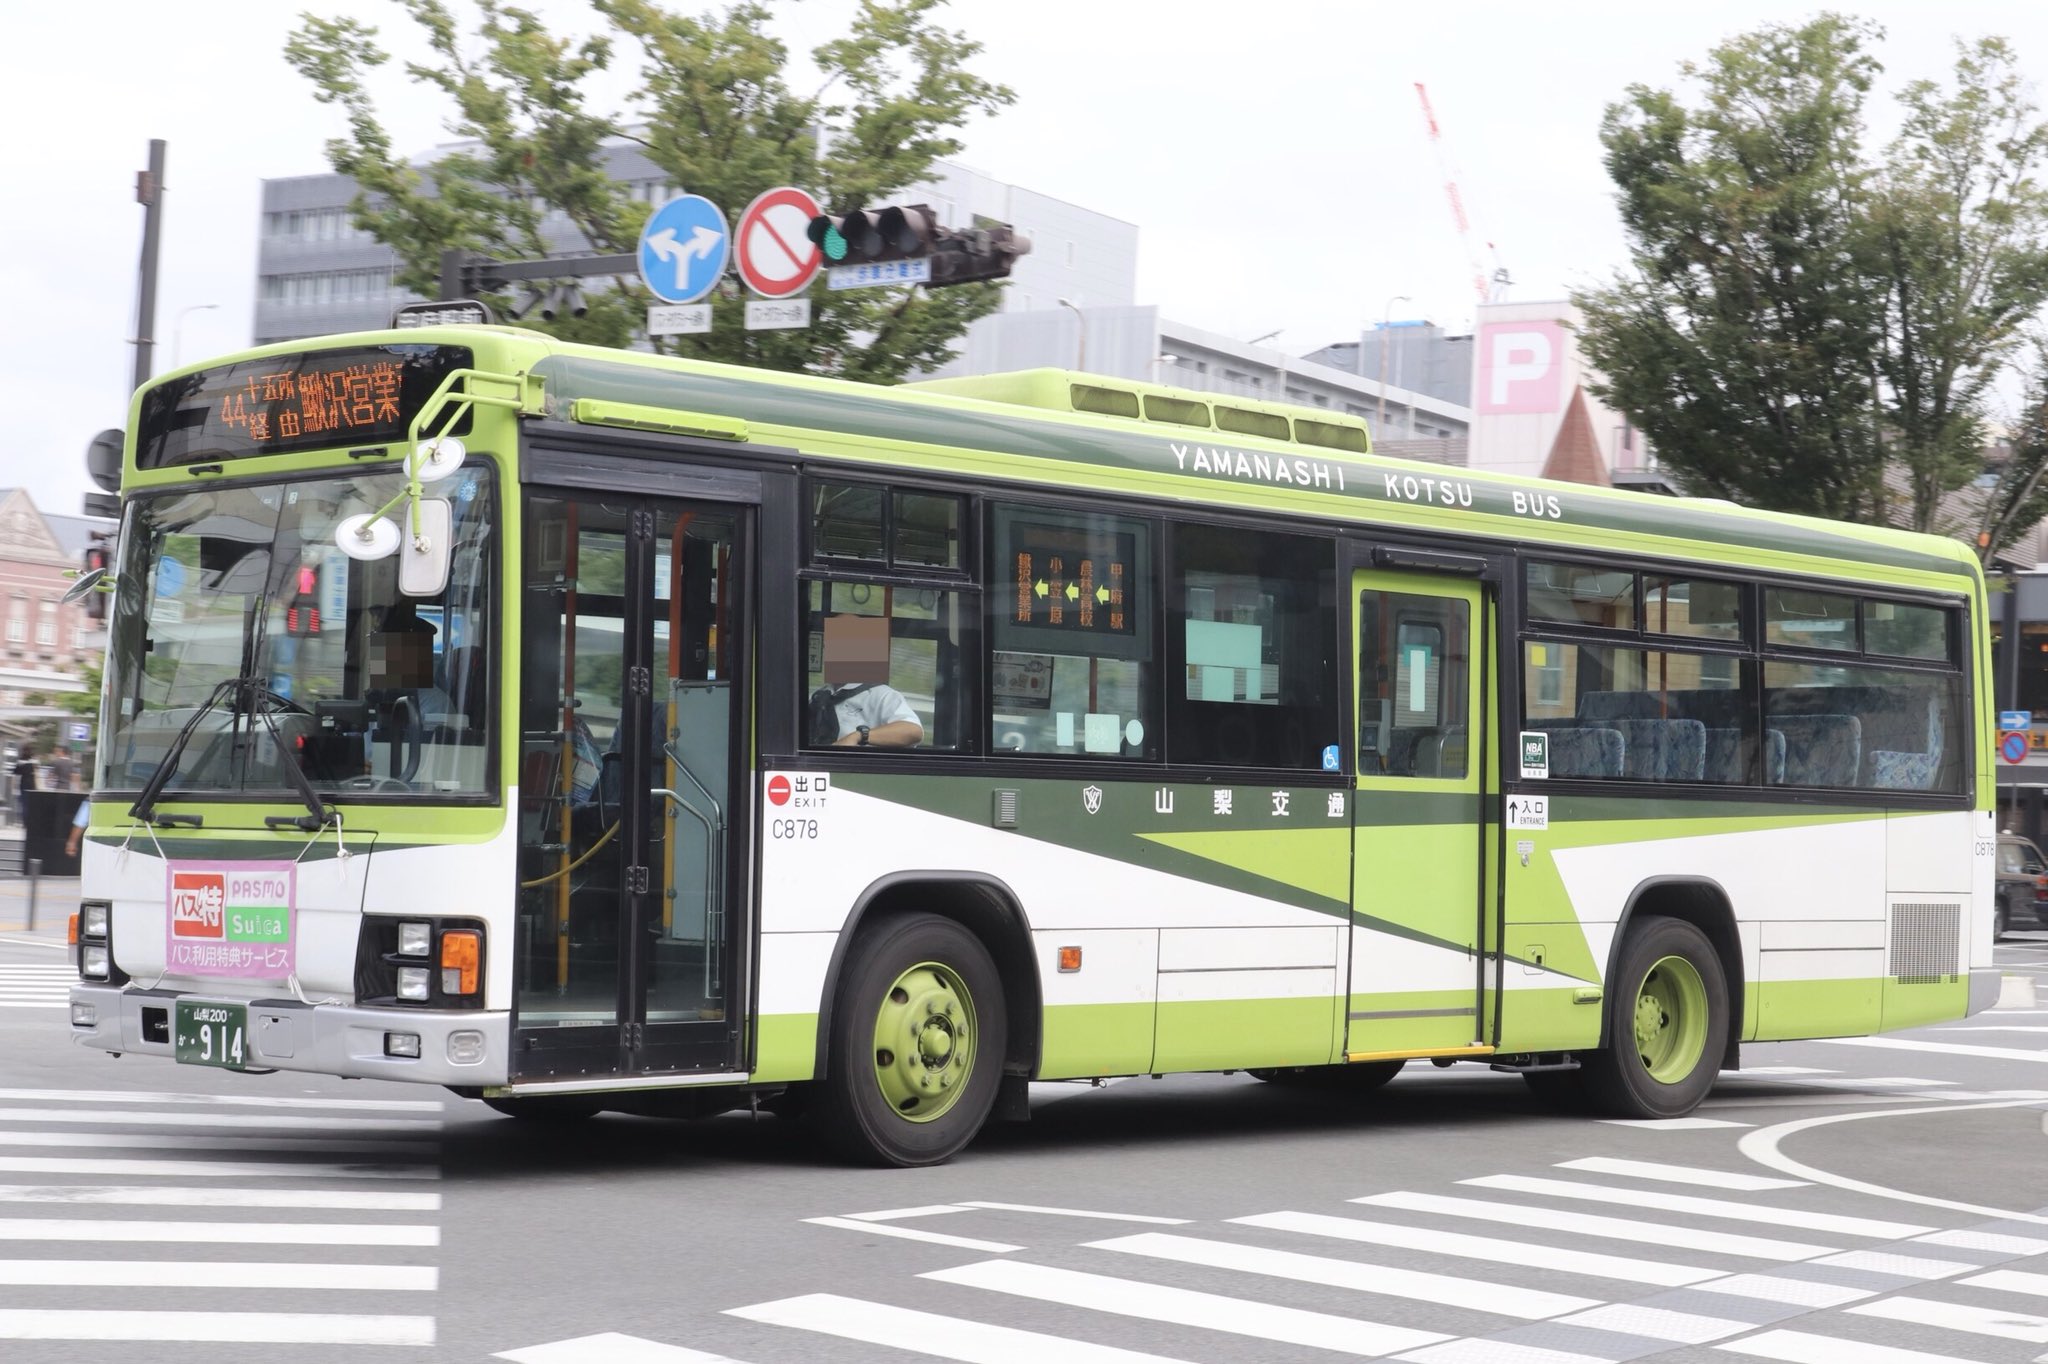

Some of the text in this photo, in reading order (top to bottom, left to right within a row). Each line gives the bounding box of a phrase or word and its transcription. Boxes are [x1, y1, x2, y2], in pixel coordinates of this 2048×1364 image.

[1491, 331, 1552, 405] P
[244, 370, 295, 405] 十五所
[299, 361, 403, 433] 鰍沢営業
[221, 393, 246, 428] 44
[250, 409, 300, 440] 経由
[1170, 442, 1562, 519] YAMANASHI KOTSU BUS
[1049, 556, 1063, 624] 小笠原
[1080, 559, 1094, 627] 農林高校
[1110, 563, 1124, 630] 甲府駅
[1525, 741, 1543, 756] NBA
[795, 775, 827, 793] 出口
[794, 797, 827, 808] EXIT
[1155, 787, 1345, 818] 山梨交通
[1521, 800, 1544, 814] 入口
[772, 818, 819, 839] C878
[1520, 816, 1545, 826] ENTRANCE
[1975, 841, 1995, 857] C878
[231, 880, 286, 900] PASMO
[232, 913, 282, 936] Suica
[171, 944, 290, 969] バス利用特典サービス
